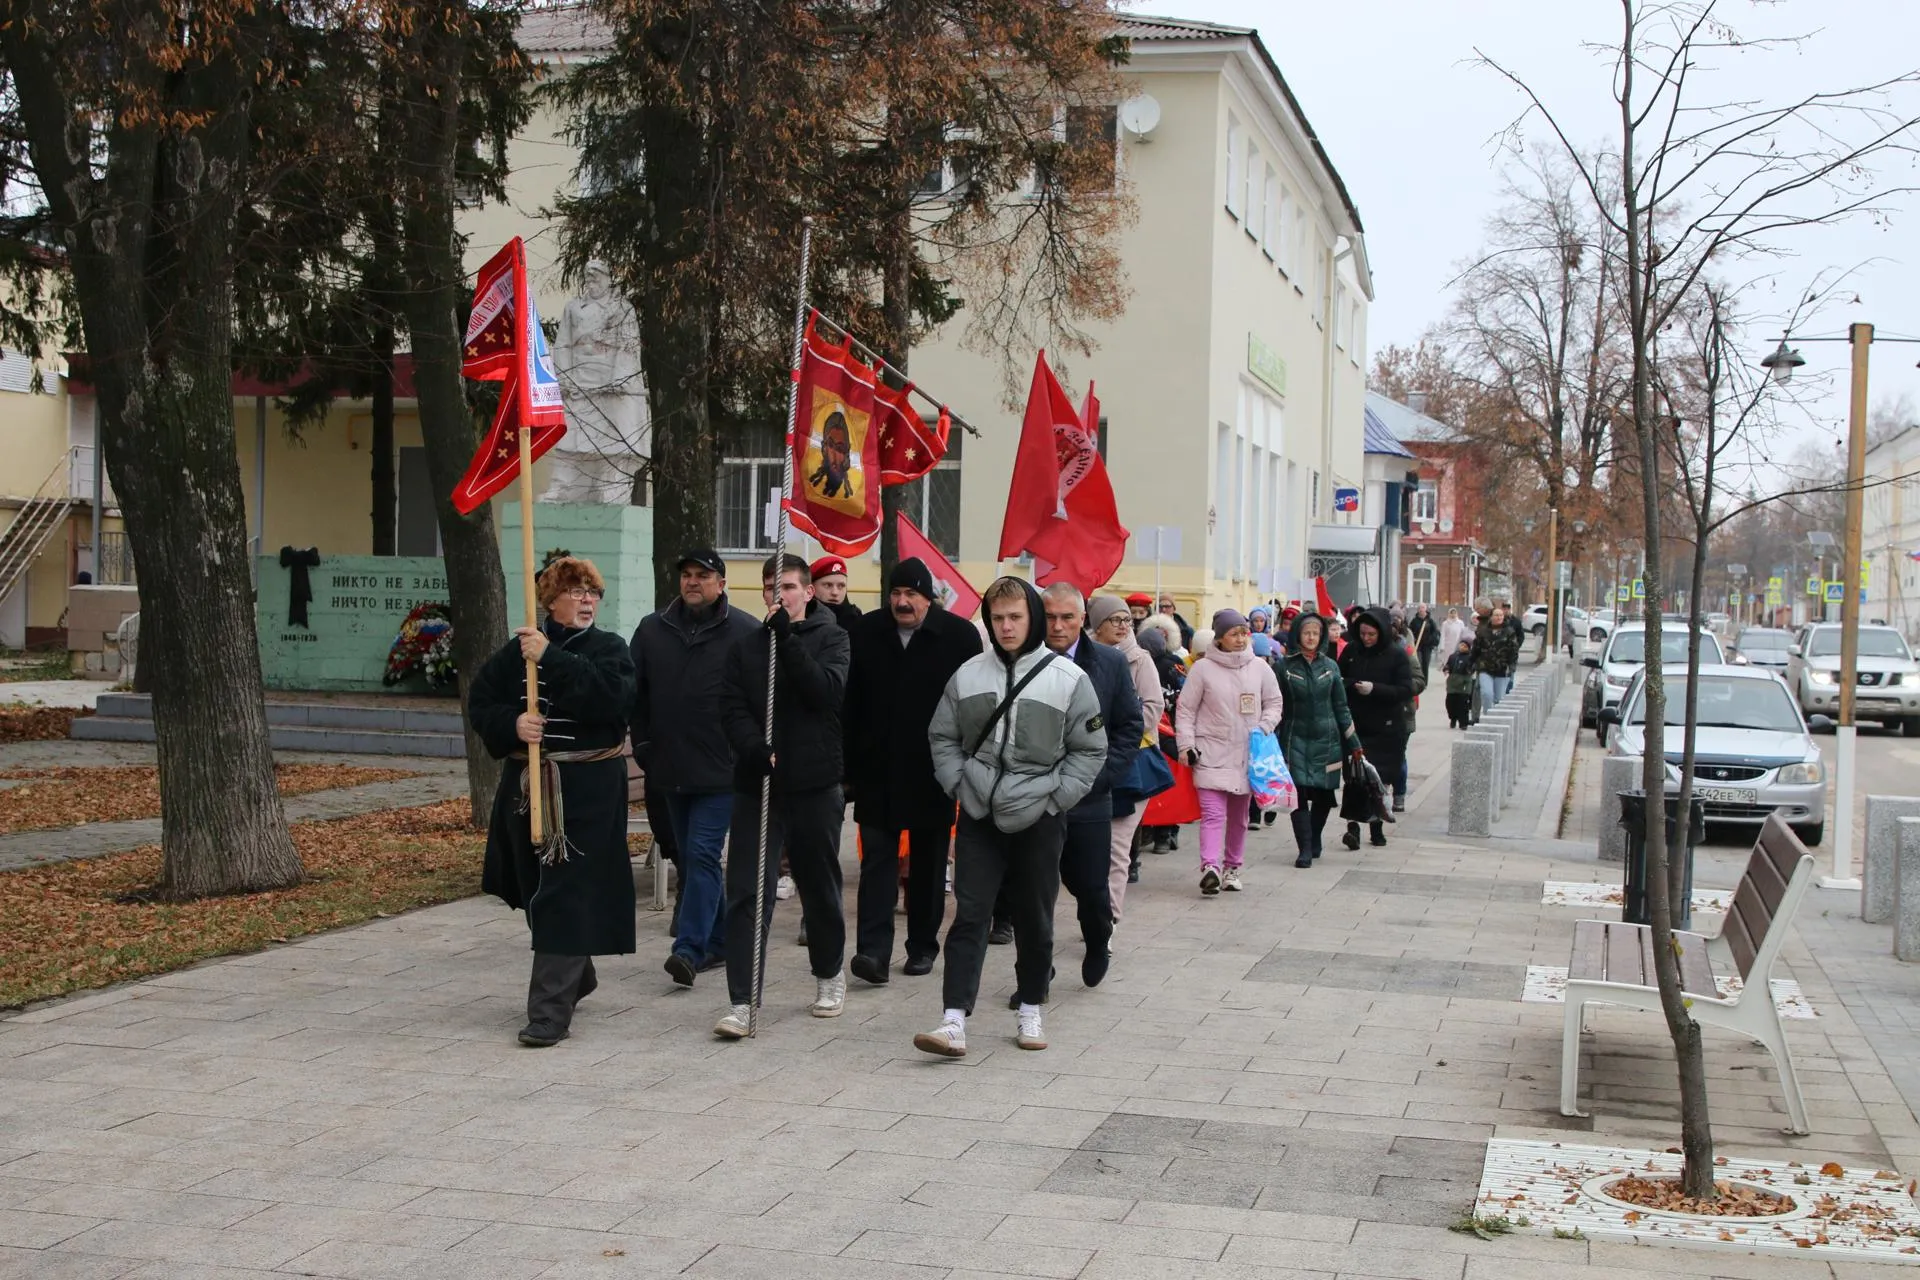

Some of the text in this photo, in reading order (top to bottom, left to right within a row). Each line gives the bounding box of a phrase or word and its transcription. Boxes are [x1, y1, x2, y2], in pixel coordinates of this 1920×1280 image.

[332, 576, 377, 588] НИКТО
[385, 577, 403, 589] НЕ
[331, 596, 377, 609] НИЧТО
